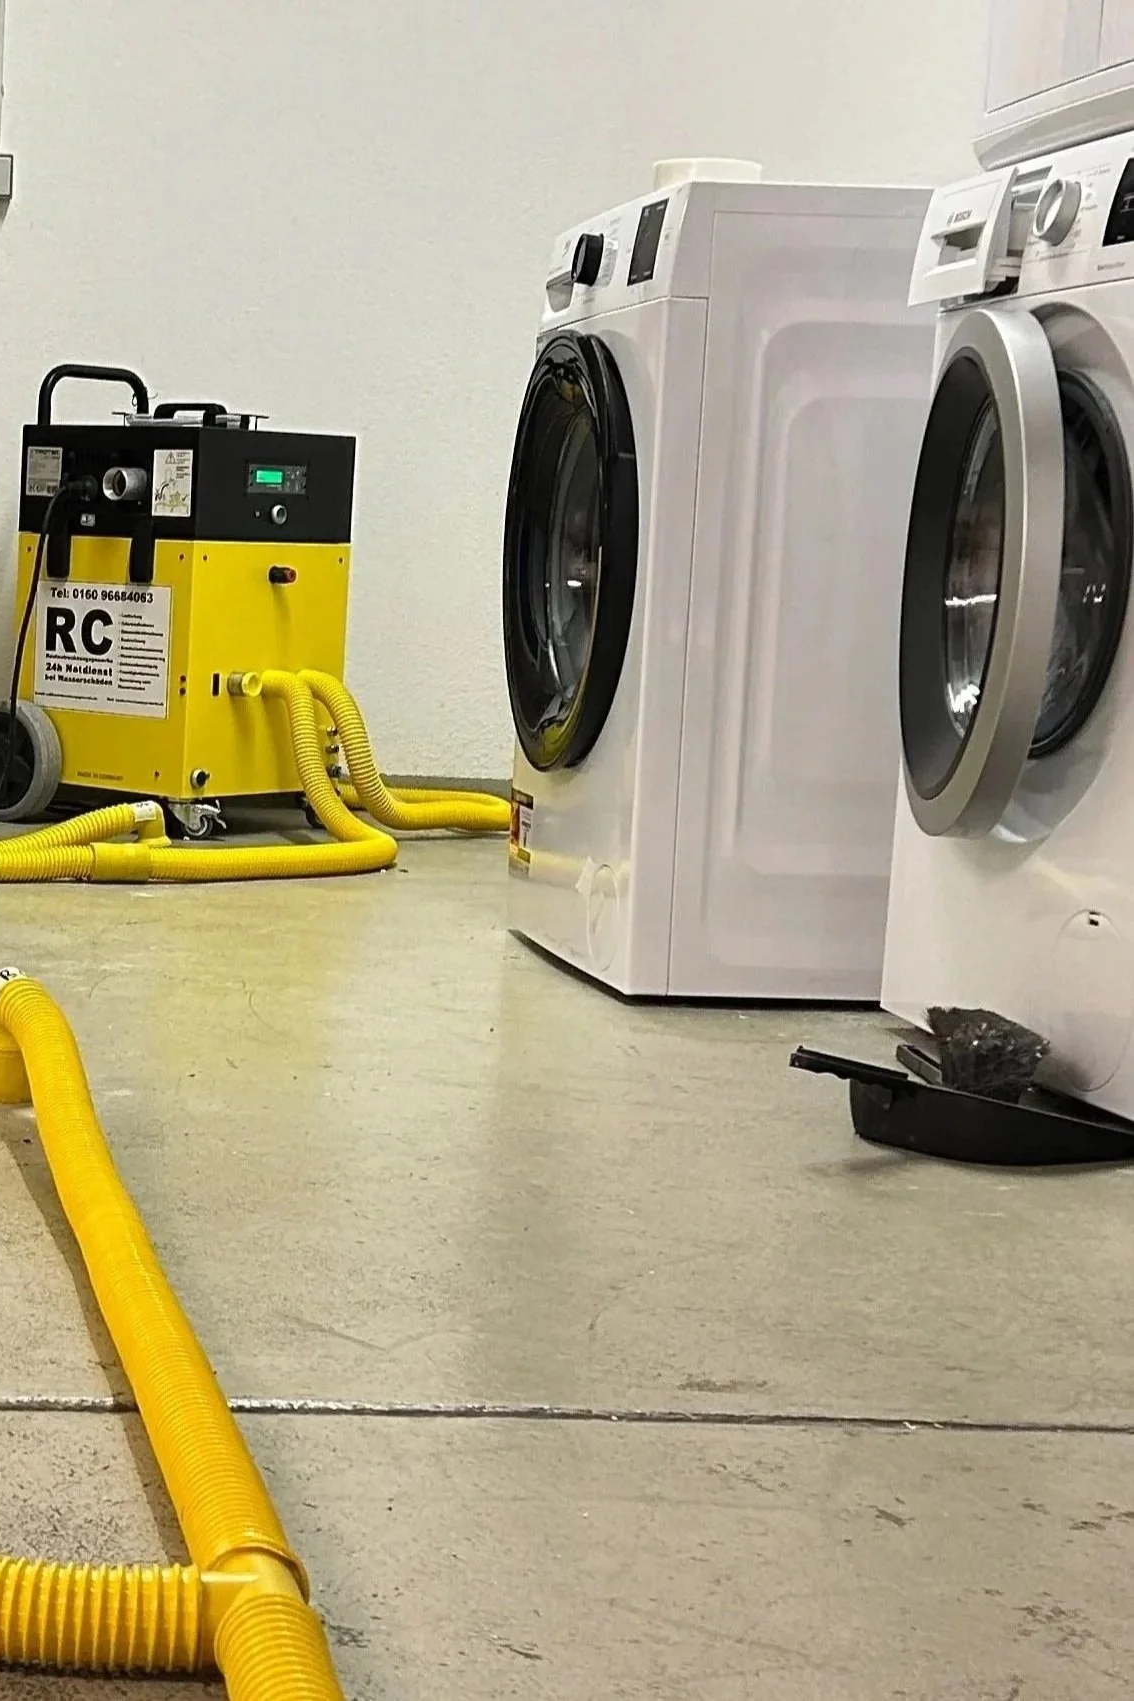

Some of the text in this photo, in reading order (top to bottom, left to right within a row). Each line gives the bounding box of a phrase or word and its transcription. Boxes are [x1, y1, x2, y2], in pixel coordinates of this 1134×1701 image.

[50, 587, 153, 603] Tel: 0160 96684063
[45, 606, 114, 656] RC
[45, 662, 63, 673] 24h
[65, 664, 113, 677] Notdienst
[44, 674, 56, 682] bei
